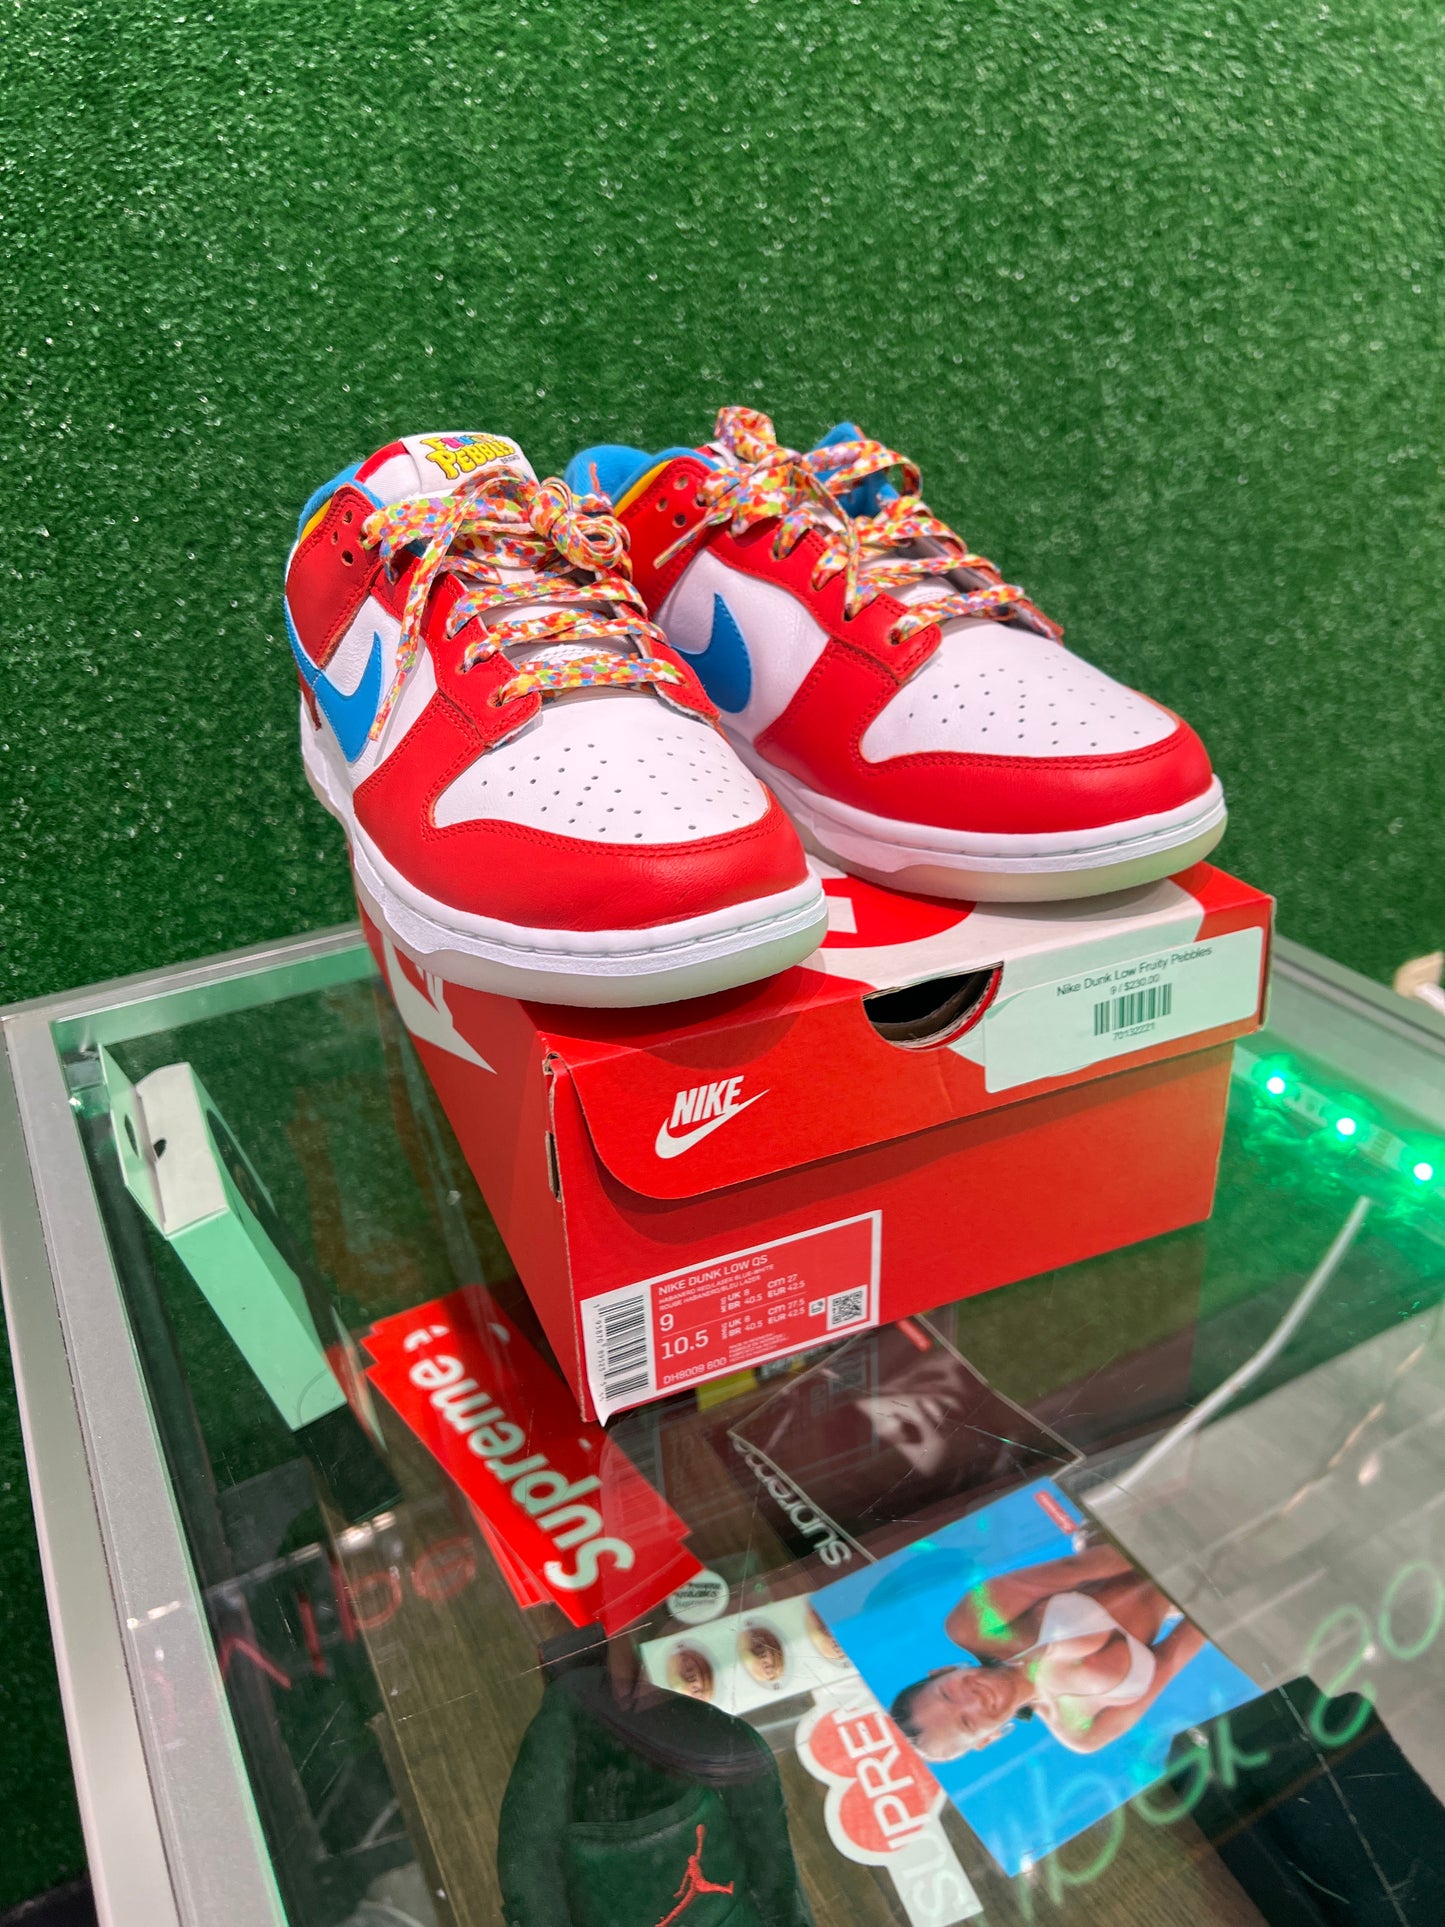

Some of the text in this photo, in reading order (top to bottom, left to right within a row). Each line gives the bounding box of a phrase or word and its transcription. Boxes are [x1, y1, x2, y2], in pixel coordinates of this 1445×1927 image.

[1057, 946, 1212, 996] Nike Dunk Low Fruity Pebbles
[669, 1075, 744, 1130] NIKE
[658, 1254, 768, 1296] NIKE DUNK LOW QS
[727, 1291, 741, 1301] UK
[767, 1286, 787, 1298] EUR
[728, 1300, 741, 1311] BR
[659, 1314, 674, 1332] 9
[728, 1318, 742, 1328] UK
[767, 1313, 787, 1325] EUR
[728, 1326, 741, 1337] BR
[661, 1329, 709, 1360] 10.5
[409, 1354, 635, 1591] Supreme
